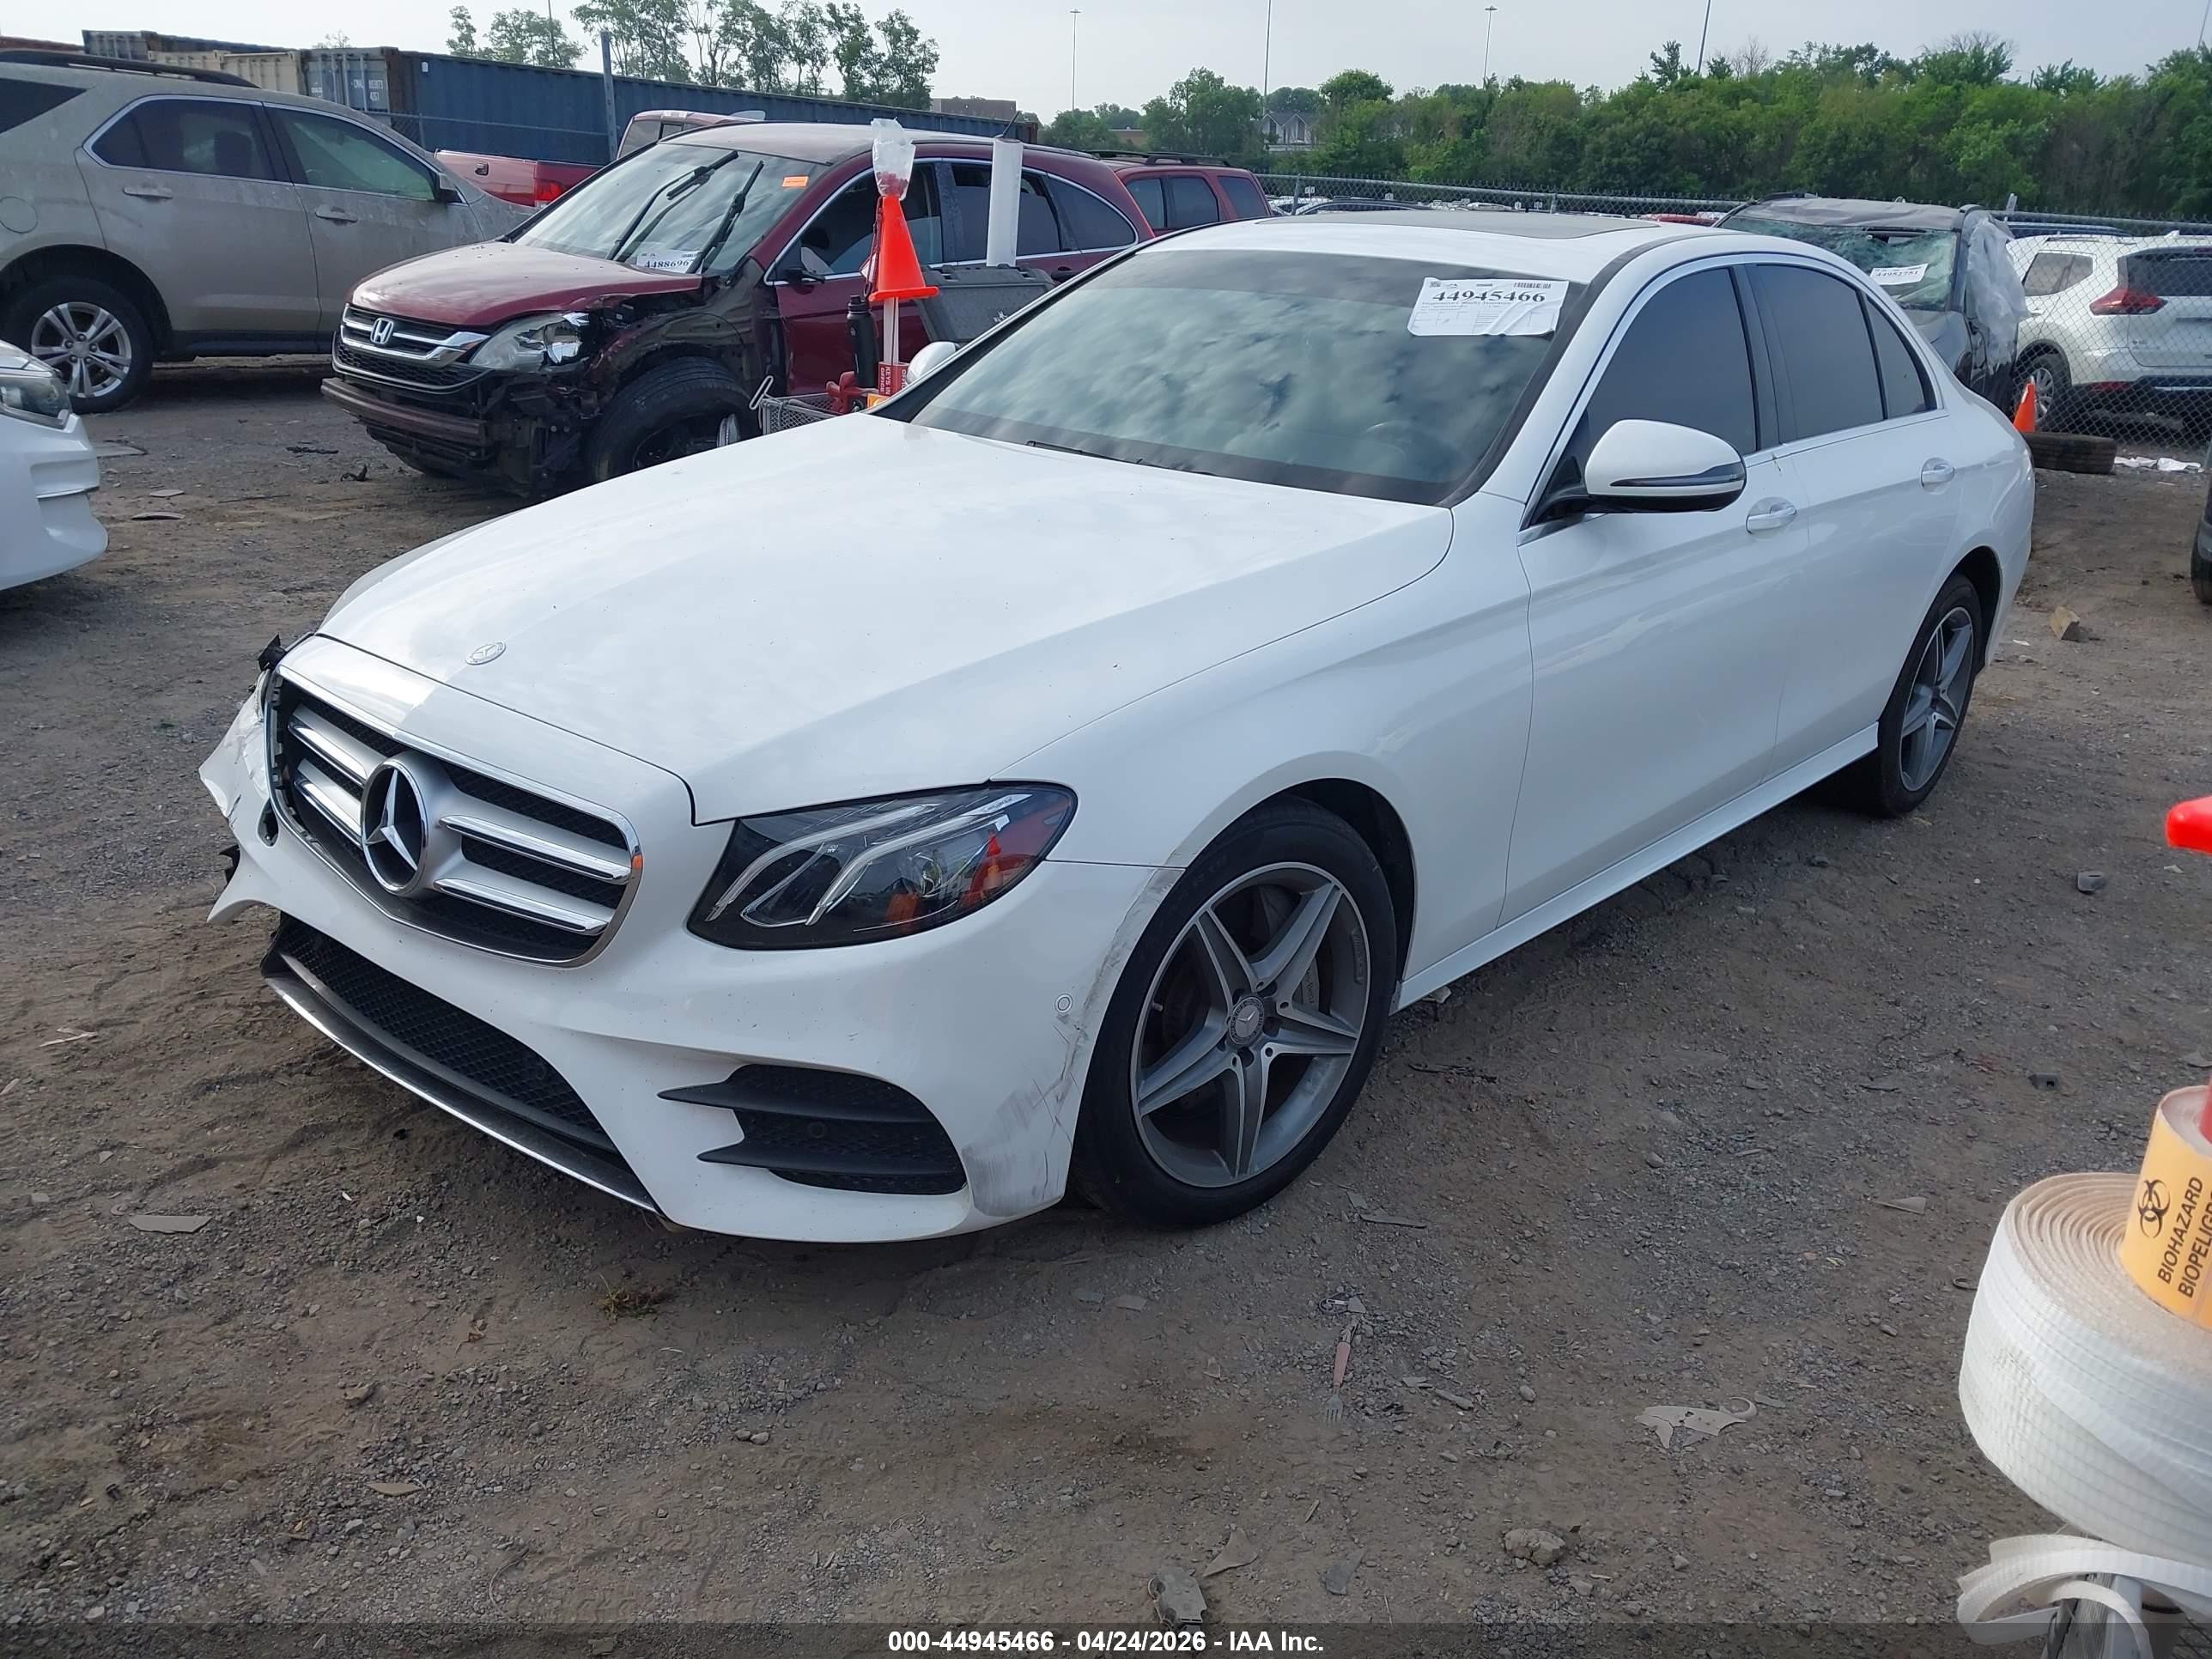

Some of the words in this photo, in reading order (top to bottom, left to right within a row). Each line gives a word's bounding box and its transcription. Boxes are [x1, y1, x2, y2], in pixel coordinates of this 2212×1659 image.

[1432, 290, 1546, 302] 44945466
[2157, 1176, 2203, 1285] BIOHAZARD
[2177, 1191, 2212, 1299] BIOPELIG
